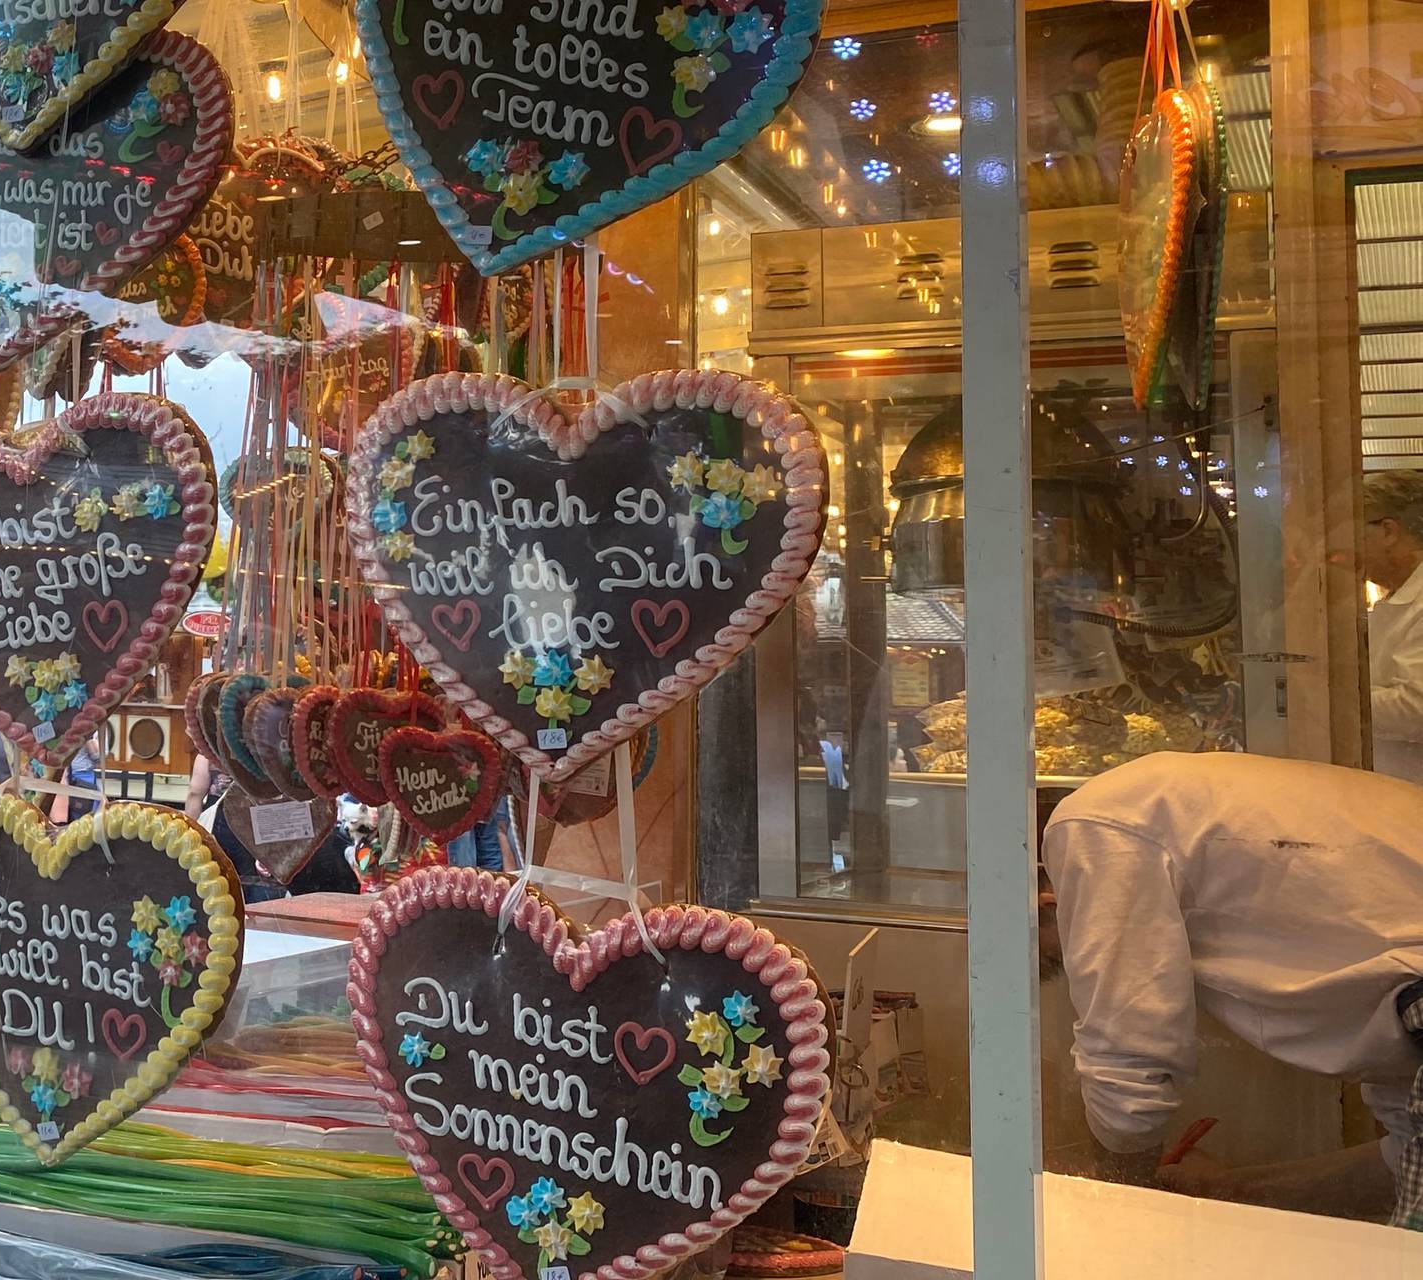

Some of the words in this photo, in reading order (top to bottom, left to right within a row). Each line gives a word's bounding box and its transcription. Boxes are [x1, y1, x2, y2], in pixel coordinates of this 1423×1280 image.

[424, 12, 494, 69] ein
[513, 24, 650, 99] tolles
[471, 72, 615, 147] Team
[49, 131, 105, 158] das
[57, 209, 94, 251] ist
[62, 170, 112, 207] mir
[113, 172, 153, 225] je
[411, 474, 600, 541] Einfach
[34, 531, 147, 606] große
[407, 546, 495, 597] weil
[508, 541, 579, 593] ich
[595, 536, 734, 593] Dich
[395, 761, 447, 793] Mein
[41, 904, 119, 947] was
[80, 944, 152, 1008] bist
[395, 976, 489, 1036] Du
[513, 992, 614, 1065] bist
[468, 1053, 598, 1119] mein
[404, 1071, 724, 1213] Sonnenschein
